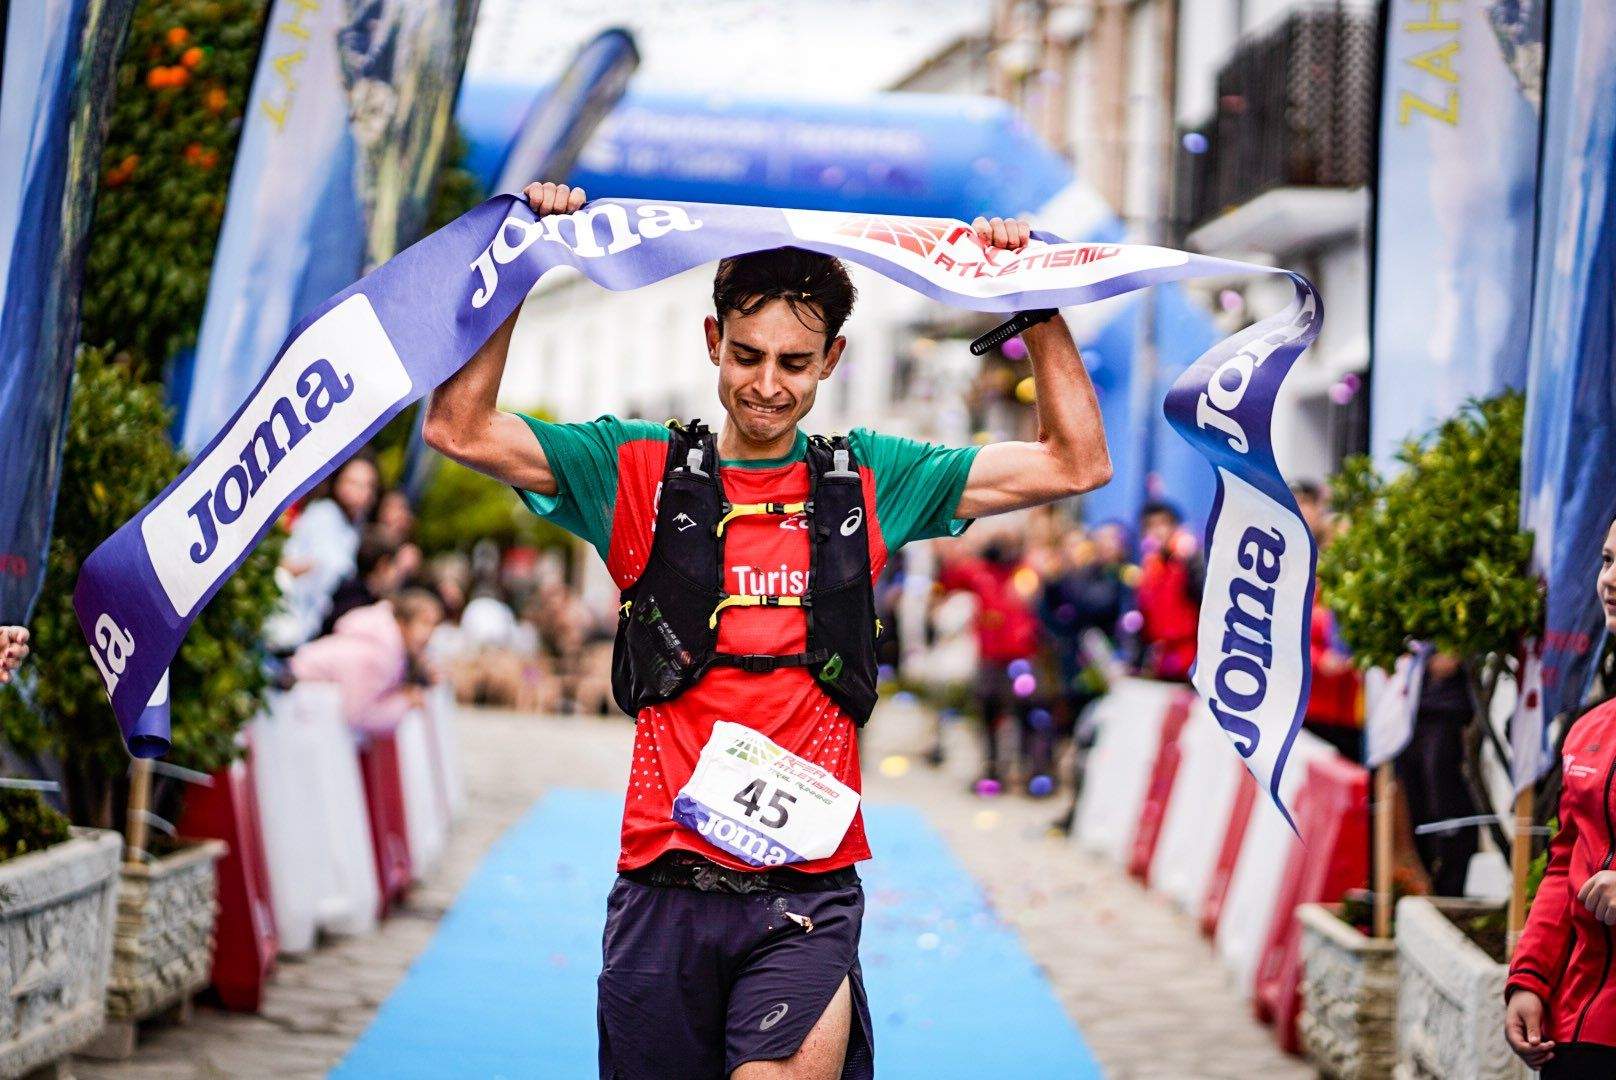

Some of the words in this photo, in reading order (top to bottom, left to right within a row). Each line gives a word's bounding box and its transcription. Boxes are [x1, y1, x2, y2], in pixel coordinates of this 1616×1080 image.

[934, 247, 1121, 278] ATLETISMO
[731, 564, 810, 596] Turis
[773, 761, 840, 799] ATLETISMO
[733, 778, 798, 829] 45
